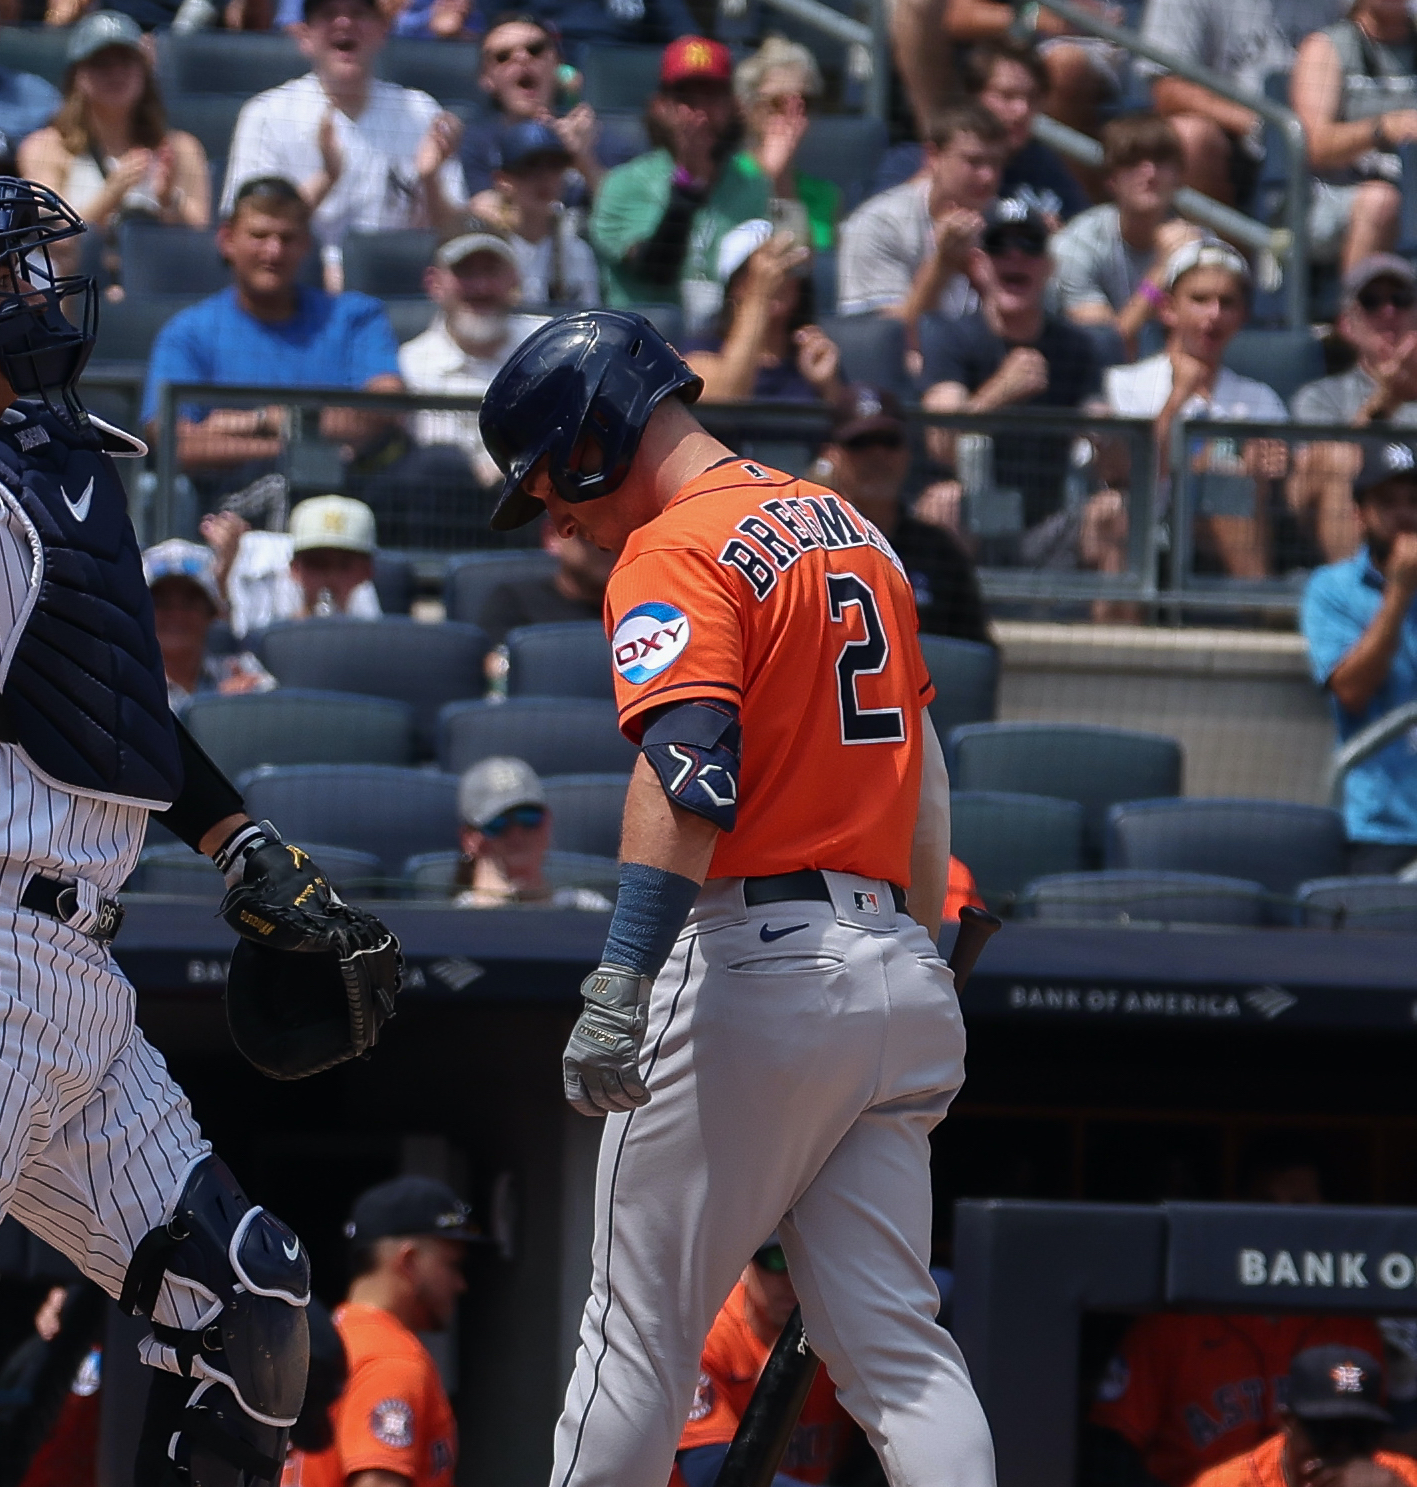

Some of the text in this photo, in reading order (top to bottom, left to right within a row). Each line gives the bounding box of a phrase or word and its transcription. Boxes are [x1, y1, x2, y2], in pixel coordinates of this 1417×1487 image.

[615, 620, 686, 666] OXY
[825, 572, 905, 745] 2
[1011, 986, 1240, 1017] BANK OF AMERICA
[1239, 1248, 1417, 1290] BANK O
